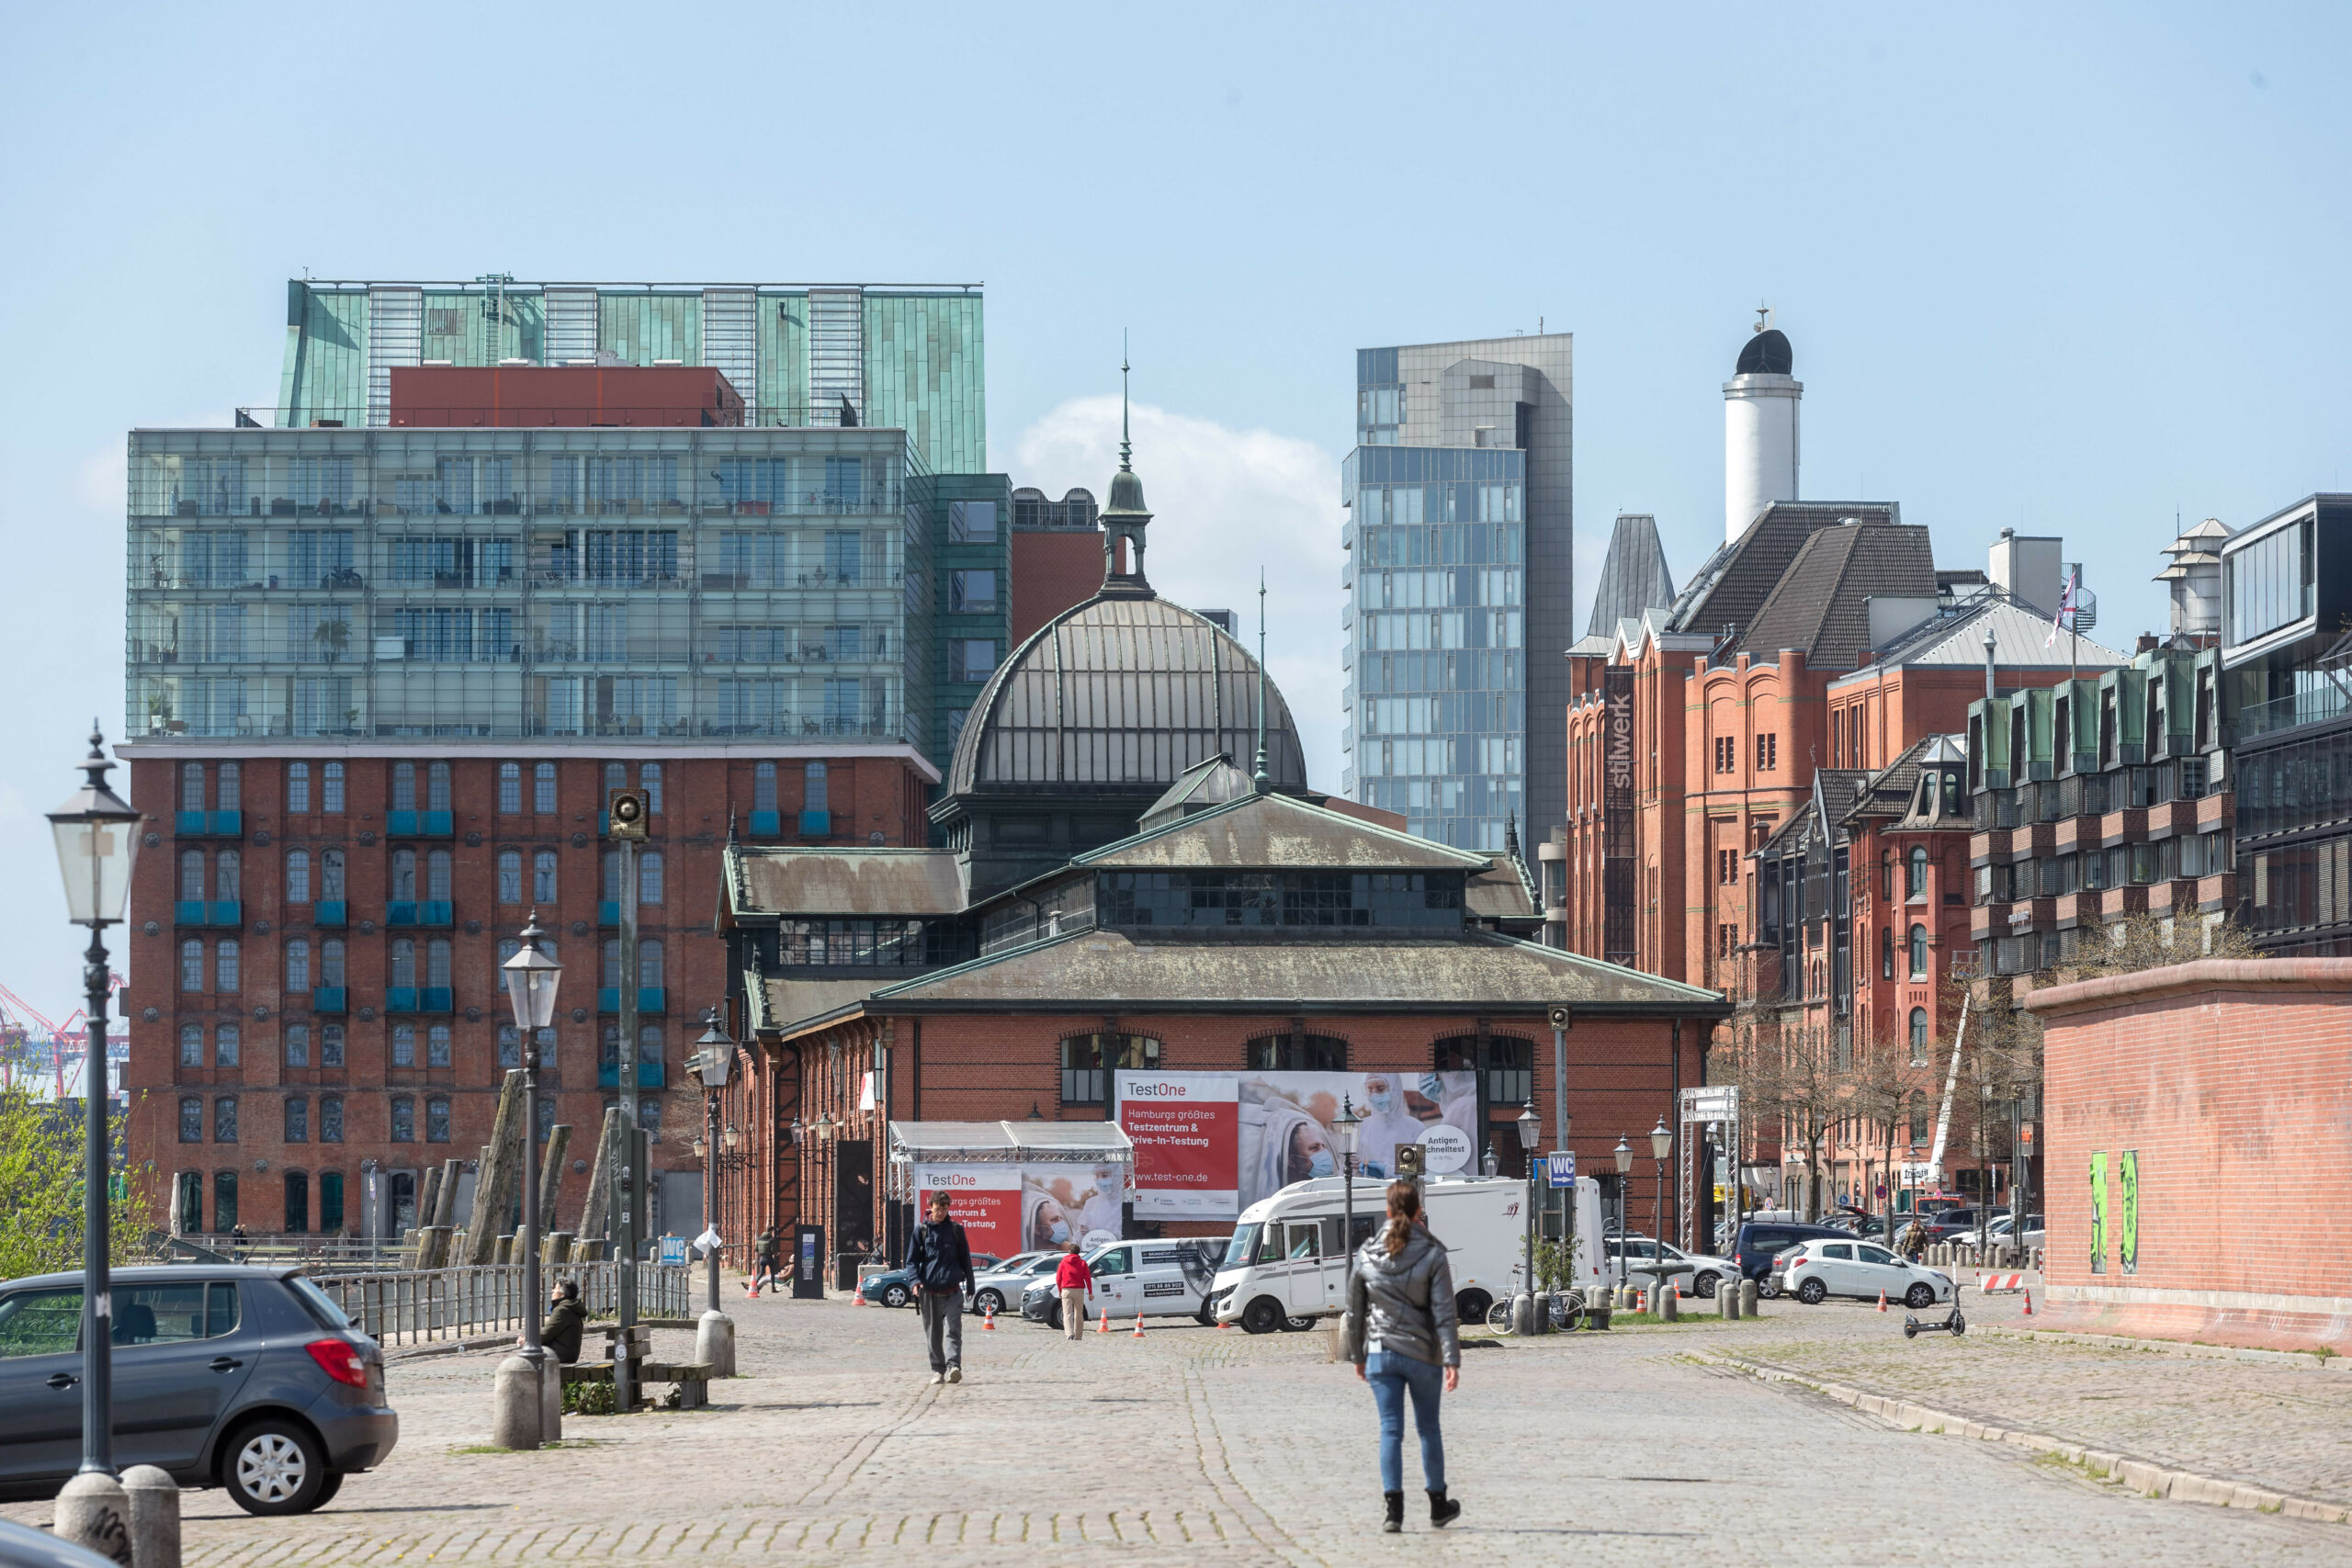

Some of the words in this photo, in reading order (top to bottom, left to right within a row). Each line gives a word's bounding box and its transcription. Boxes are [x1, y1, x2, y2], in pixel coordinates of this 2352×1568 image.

[1608, 694, 1631, 789] stilwerk
[1127, 1082, 1186, 1096] TestOne
[1128, 1109, 1175, 1121] Hamburgs
[1178, 1110, 1216, 1121] größtes
[1128, 1122, 1189, 1133] Testzentrum
[1191, 1123, 1198, 1133] &
[1129, 1135, 1209, 1147] Drive-In-Testung
[1428, 1136, 1458, 1145] Antigen
[1425, 1145, 1464, 1154] chnelltest
[1552, 1156, 1574, 1175] WC
[926, 1173, 977, 1186] TestOne
[926, 1197, 967, 1207] Hurgs
[968, 1197, 1001, 1207] größtes
[980, 1209, 987, 1217] &
[663, 1239, 684, 1256] WC
